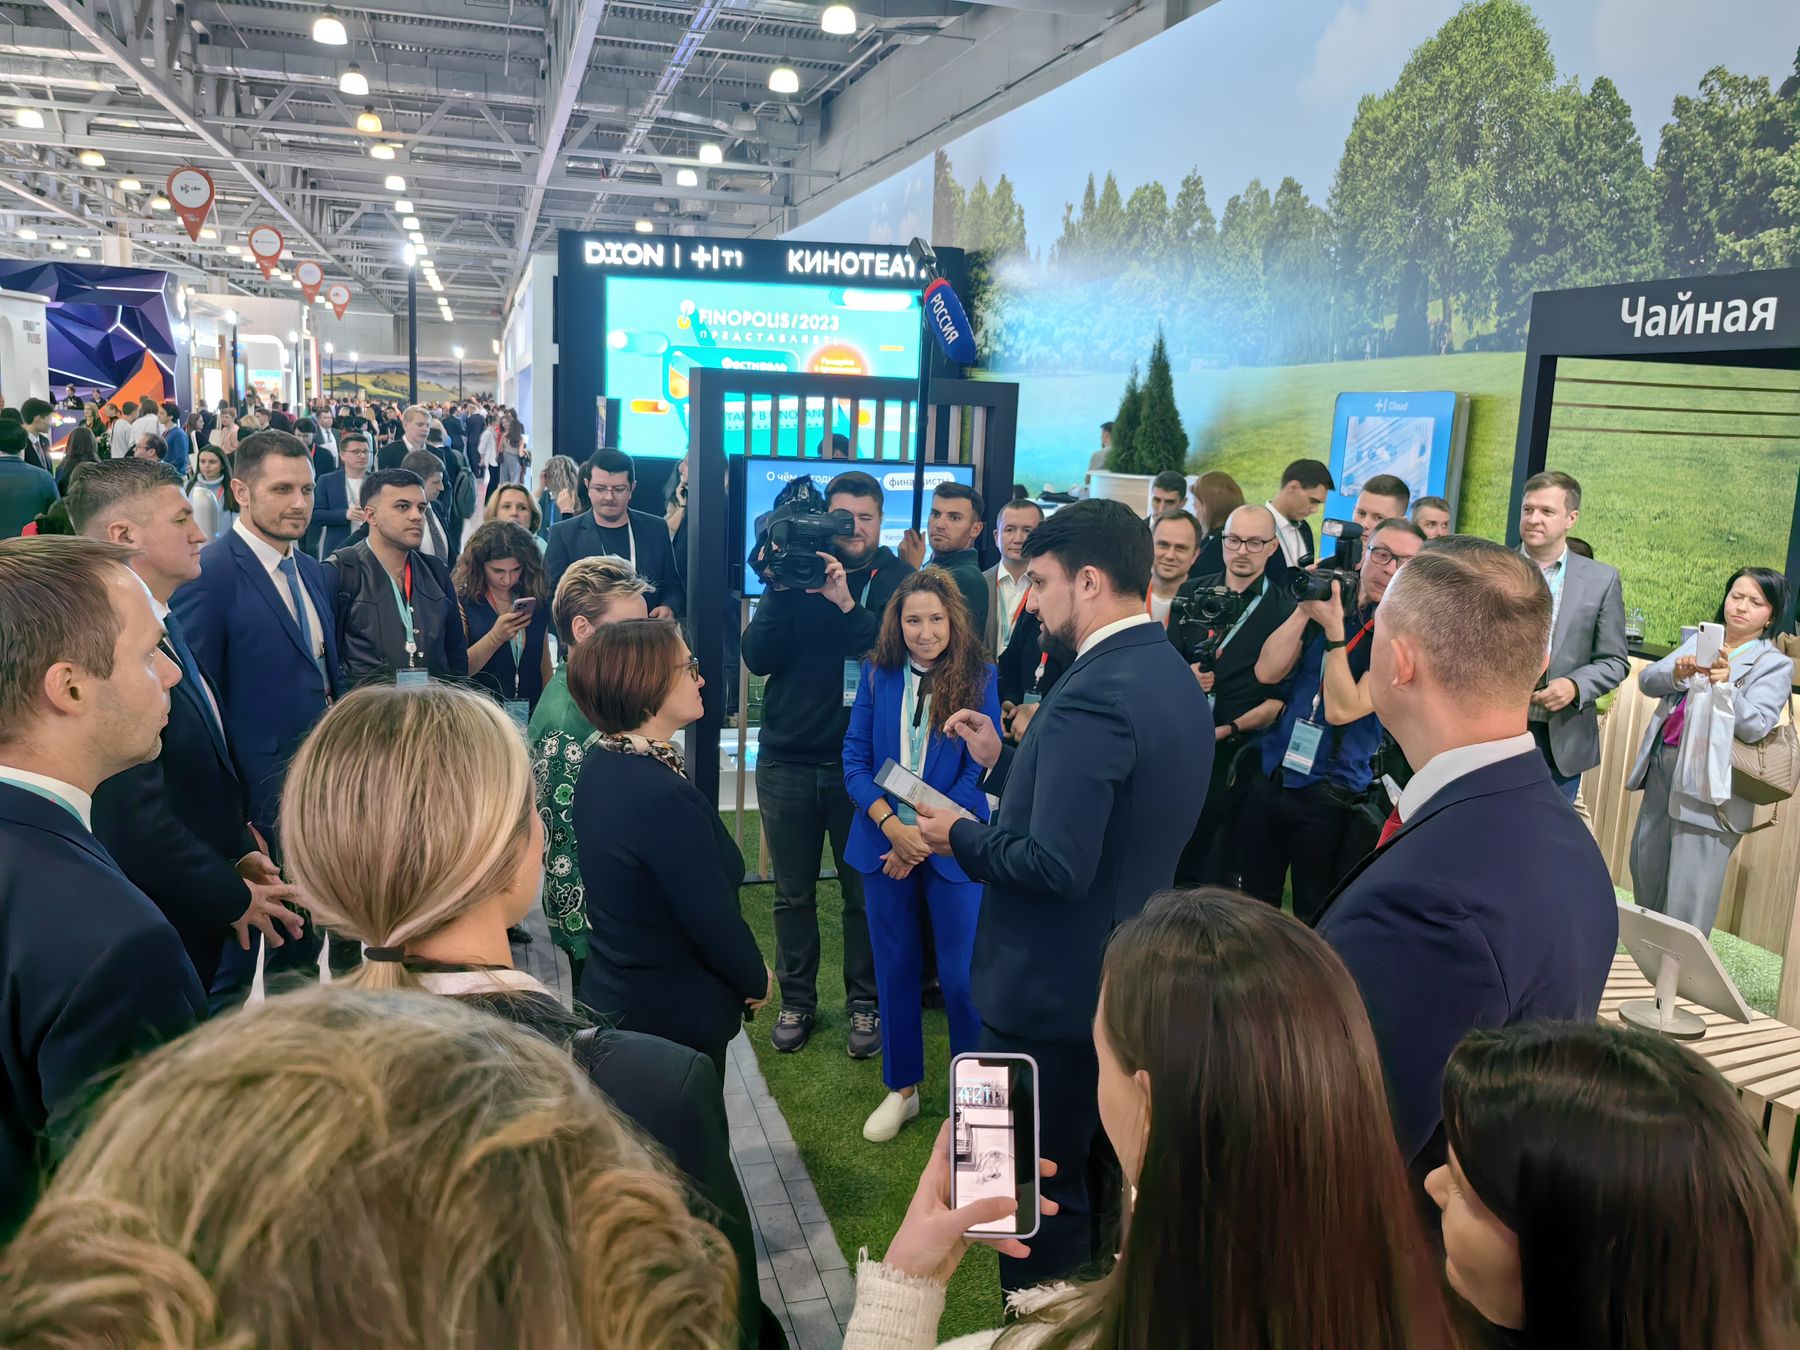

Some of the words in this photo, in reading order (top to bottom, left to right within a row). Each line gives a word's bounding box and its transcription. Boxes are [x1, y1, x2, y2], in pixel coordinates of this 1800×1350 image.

[585, 241, 664, 267] DION
[788, 249, 926, 279] КИНОТЕАТ
[930, 292, 960, 345] РОССИЯ
[1621, 291, 1778, 338] Чайная
[1388, 401, 1408, 411] Cloud
